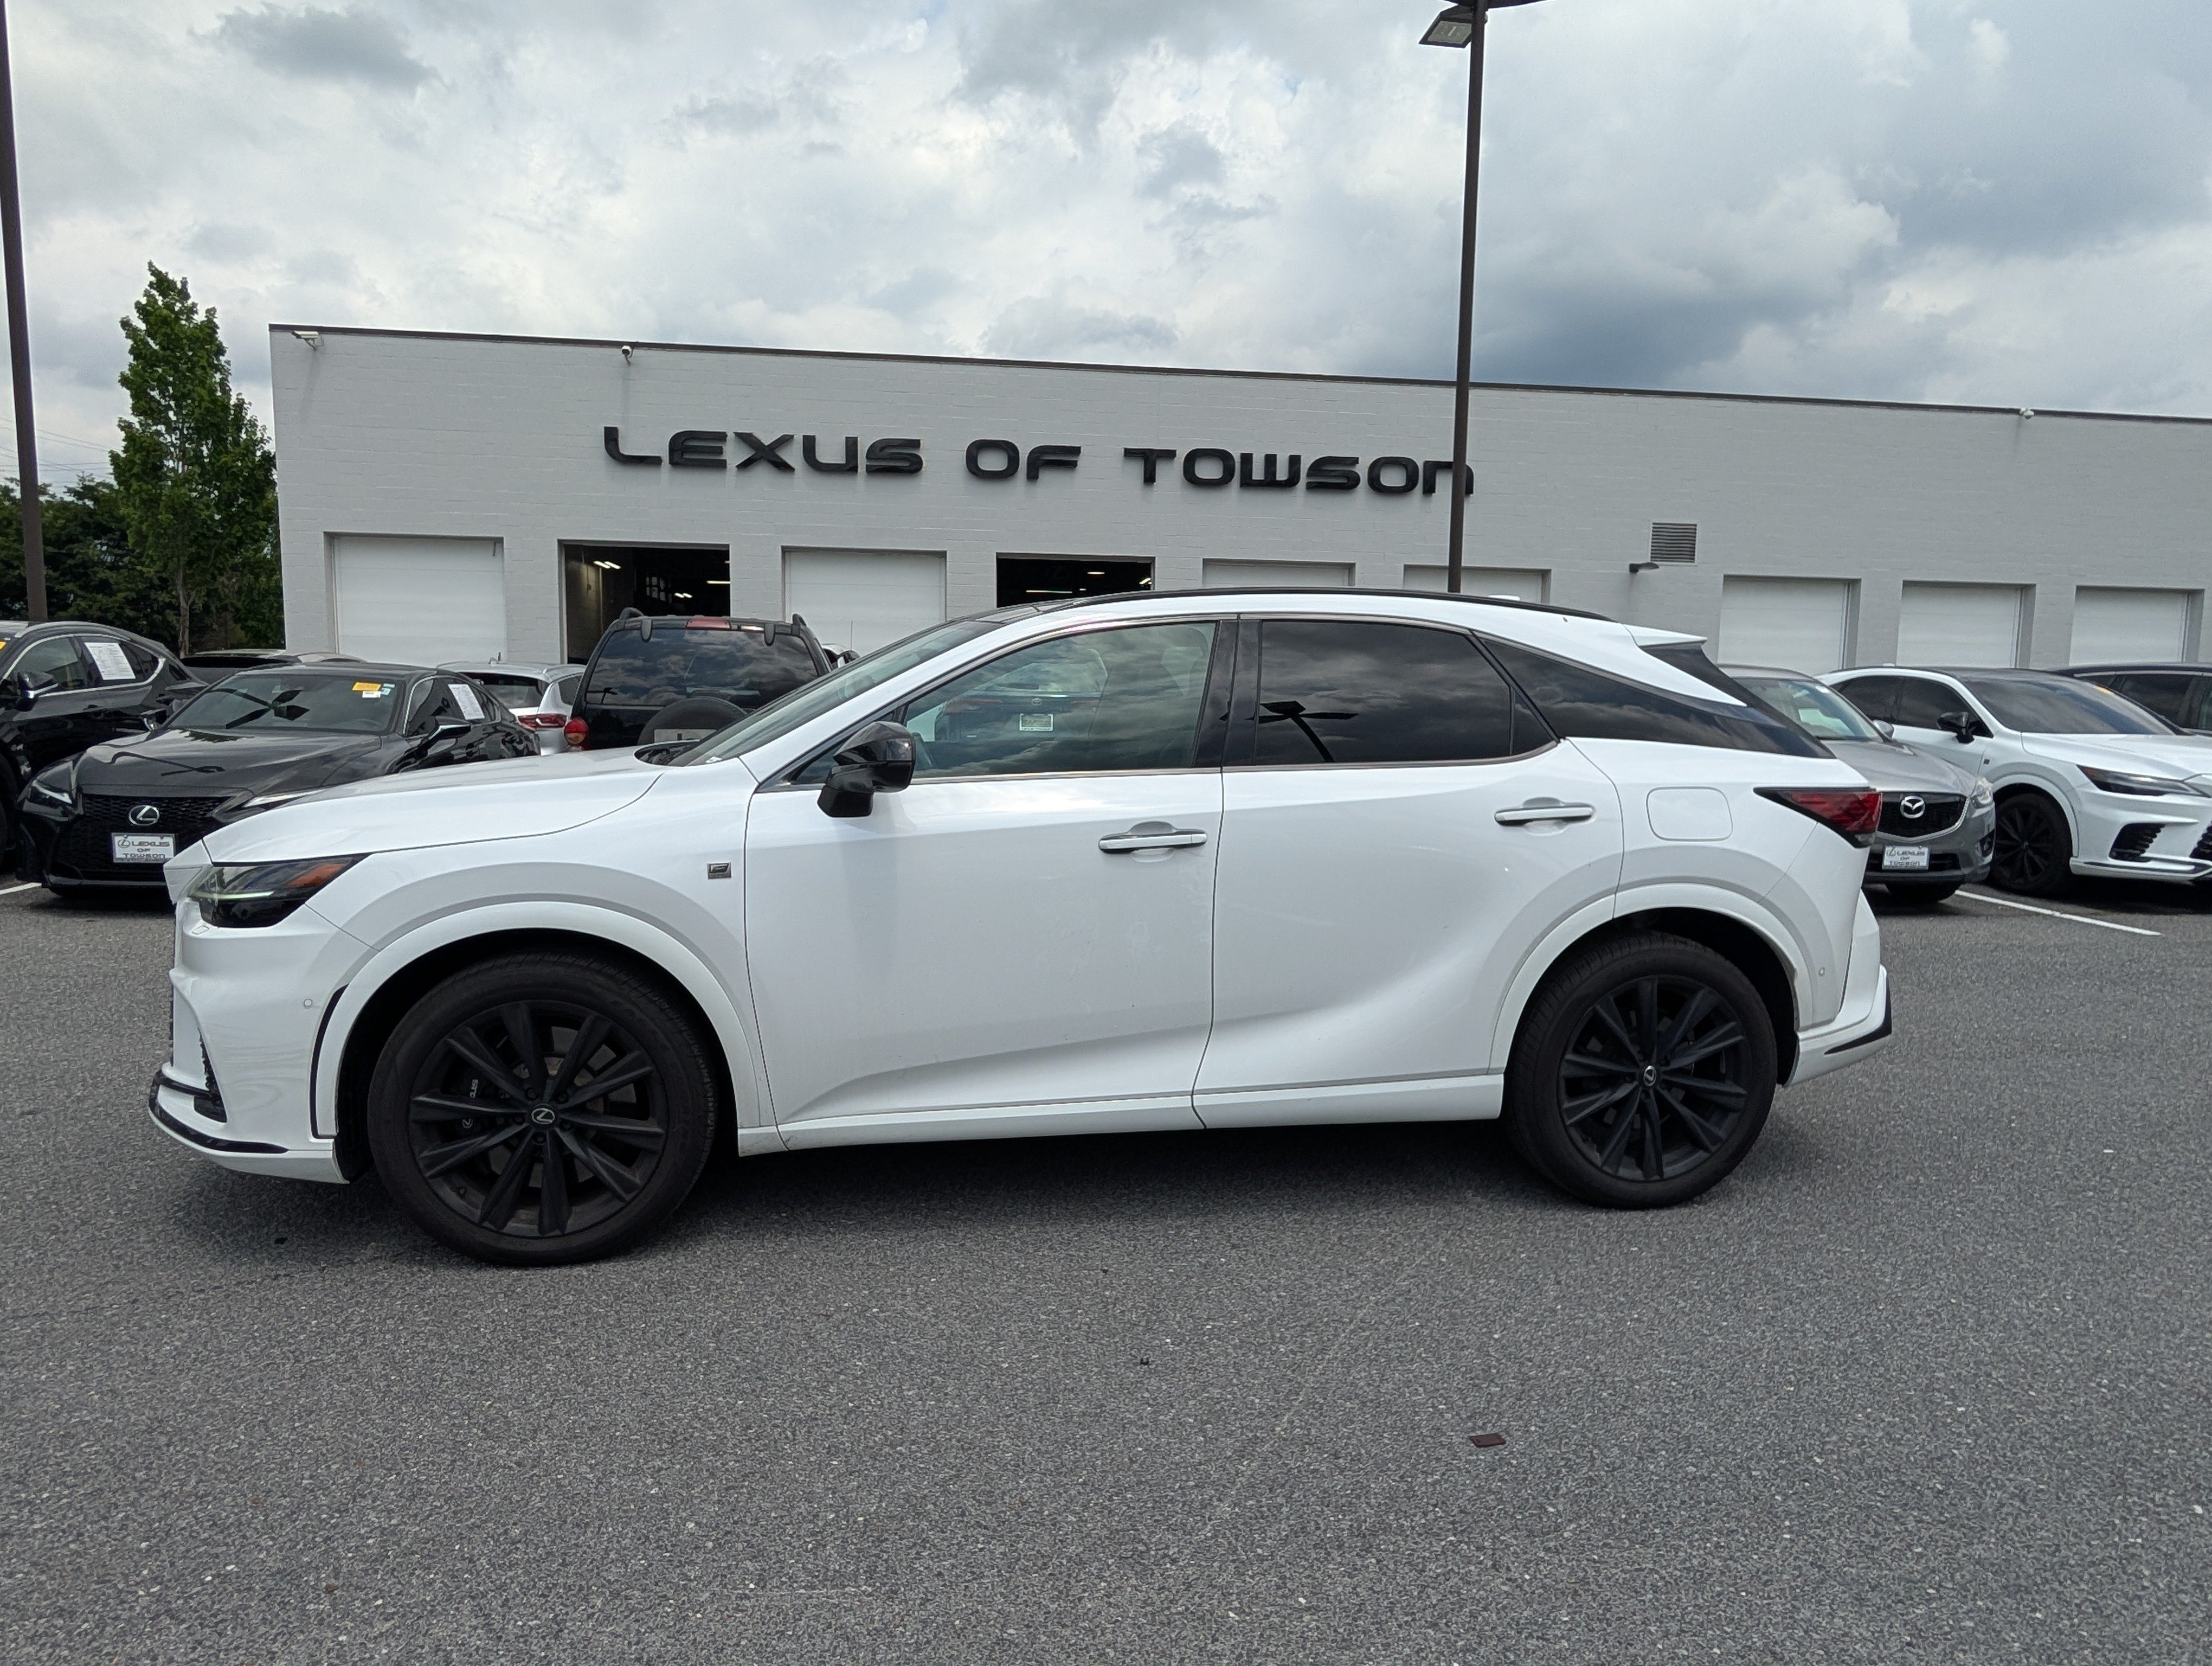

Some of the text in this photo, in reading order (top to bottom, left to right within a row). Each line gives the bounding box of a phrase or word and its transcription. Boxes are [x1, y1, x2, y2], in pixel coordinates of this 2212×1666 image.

[603, 426, 1475, 495] LEXUS OF TOWSON
